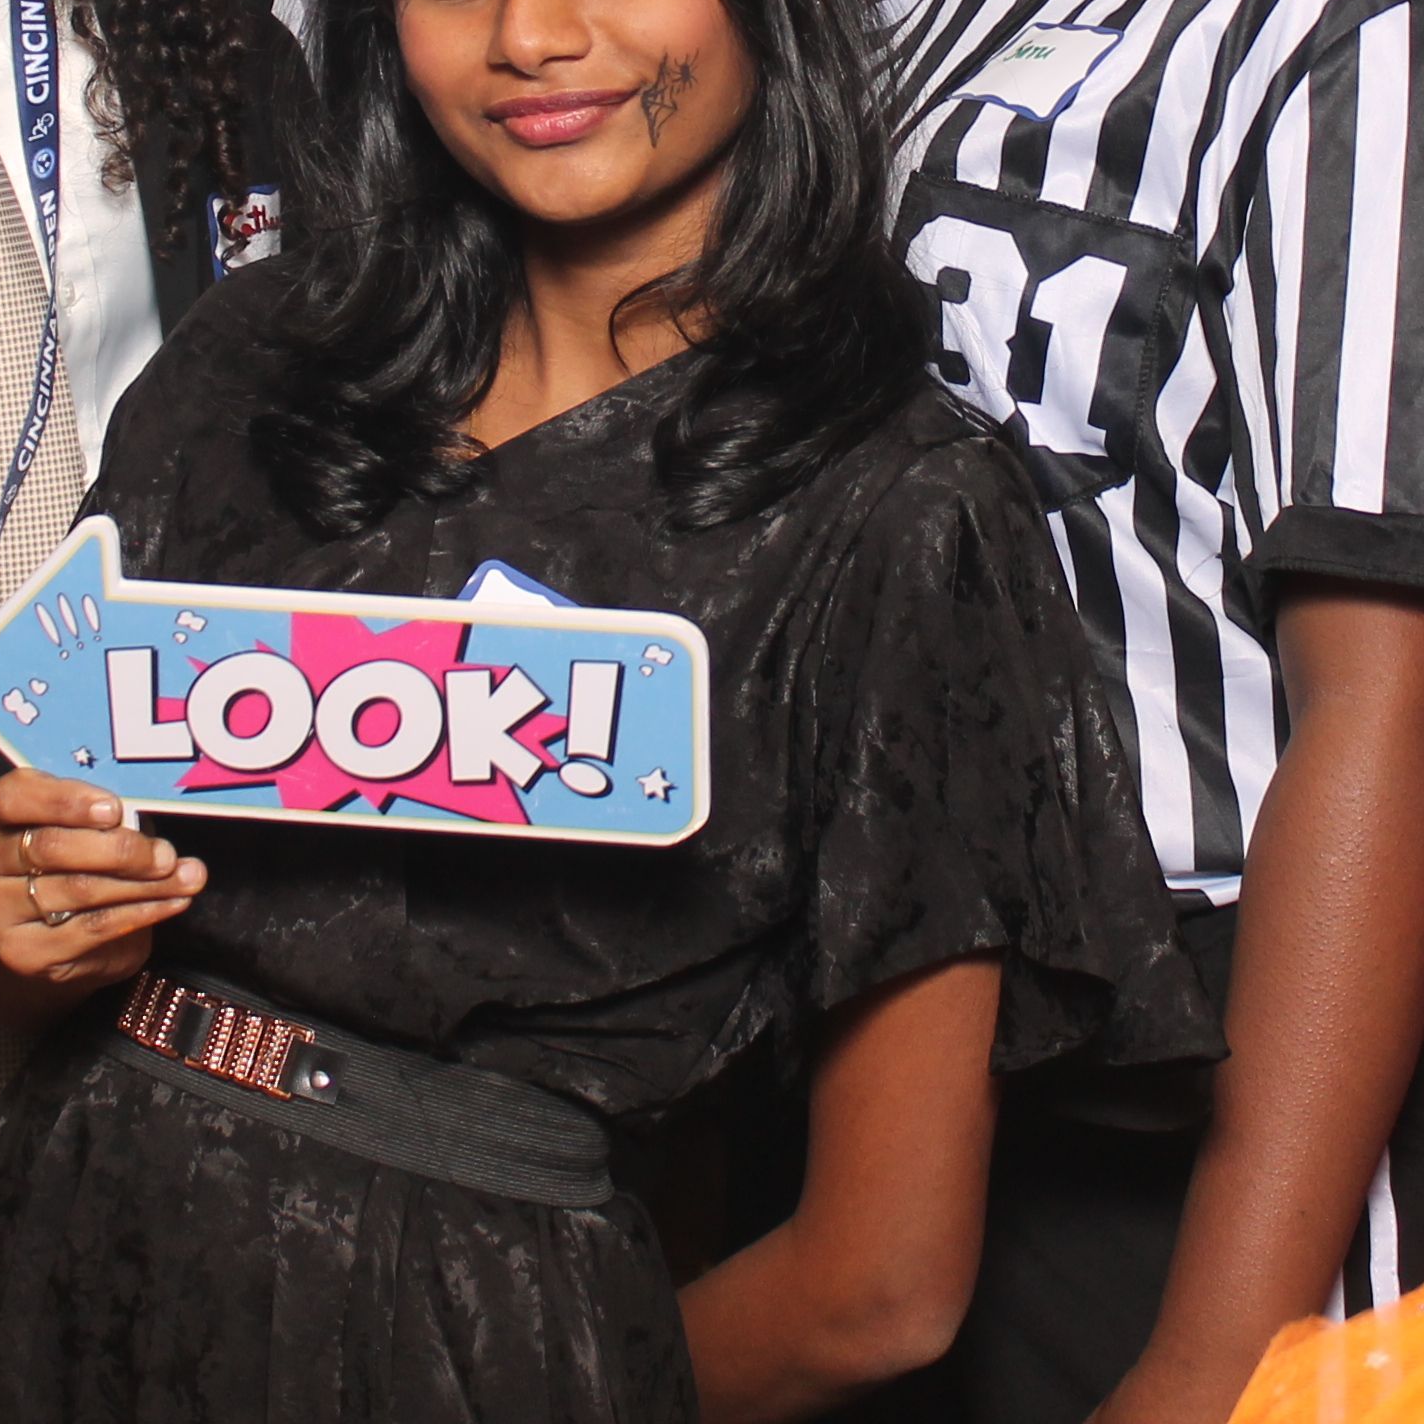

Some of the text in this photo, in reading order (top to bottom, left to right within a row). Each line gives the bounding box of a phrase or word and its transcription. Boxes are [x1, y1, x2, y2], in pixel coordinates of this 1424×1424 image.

[16, 316, 57, 472] CINCINNA
[904, 214, 1128, 458] 31
[105, 646, 623, 798] LOOK!
